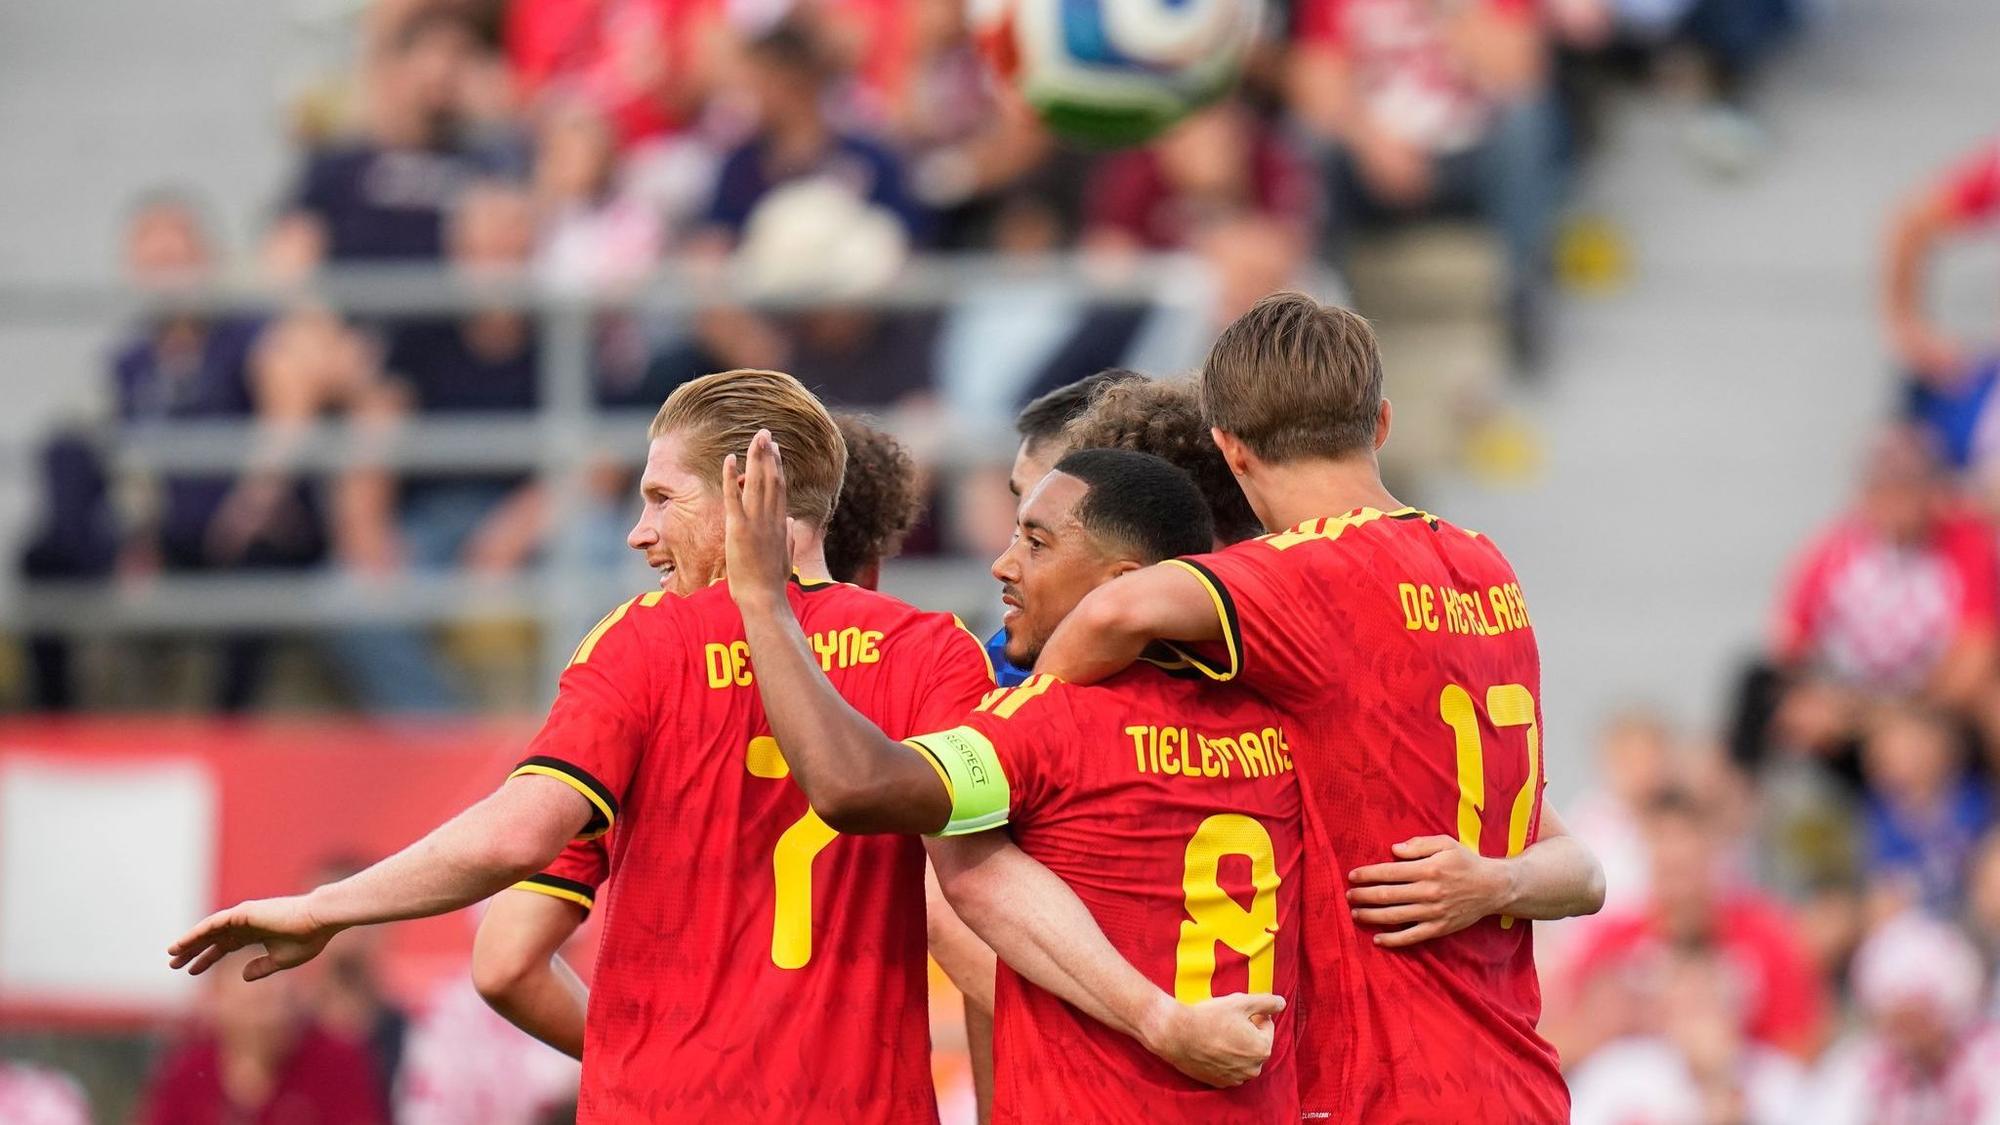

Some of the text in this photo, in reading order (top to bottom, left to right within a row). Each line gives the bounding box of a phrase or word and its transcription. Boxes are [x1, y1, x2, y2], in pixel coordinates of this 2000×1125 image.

[705, 626, 884, 689] DE YNE
[1398, 582, 1439, 632] DE
[745, 736, 840, 969] 7
[1440, 684, 1538, 930] 17
[1175, 813, 1281, 1007] 8
